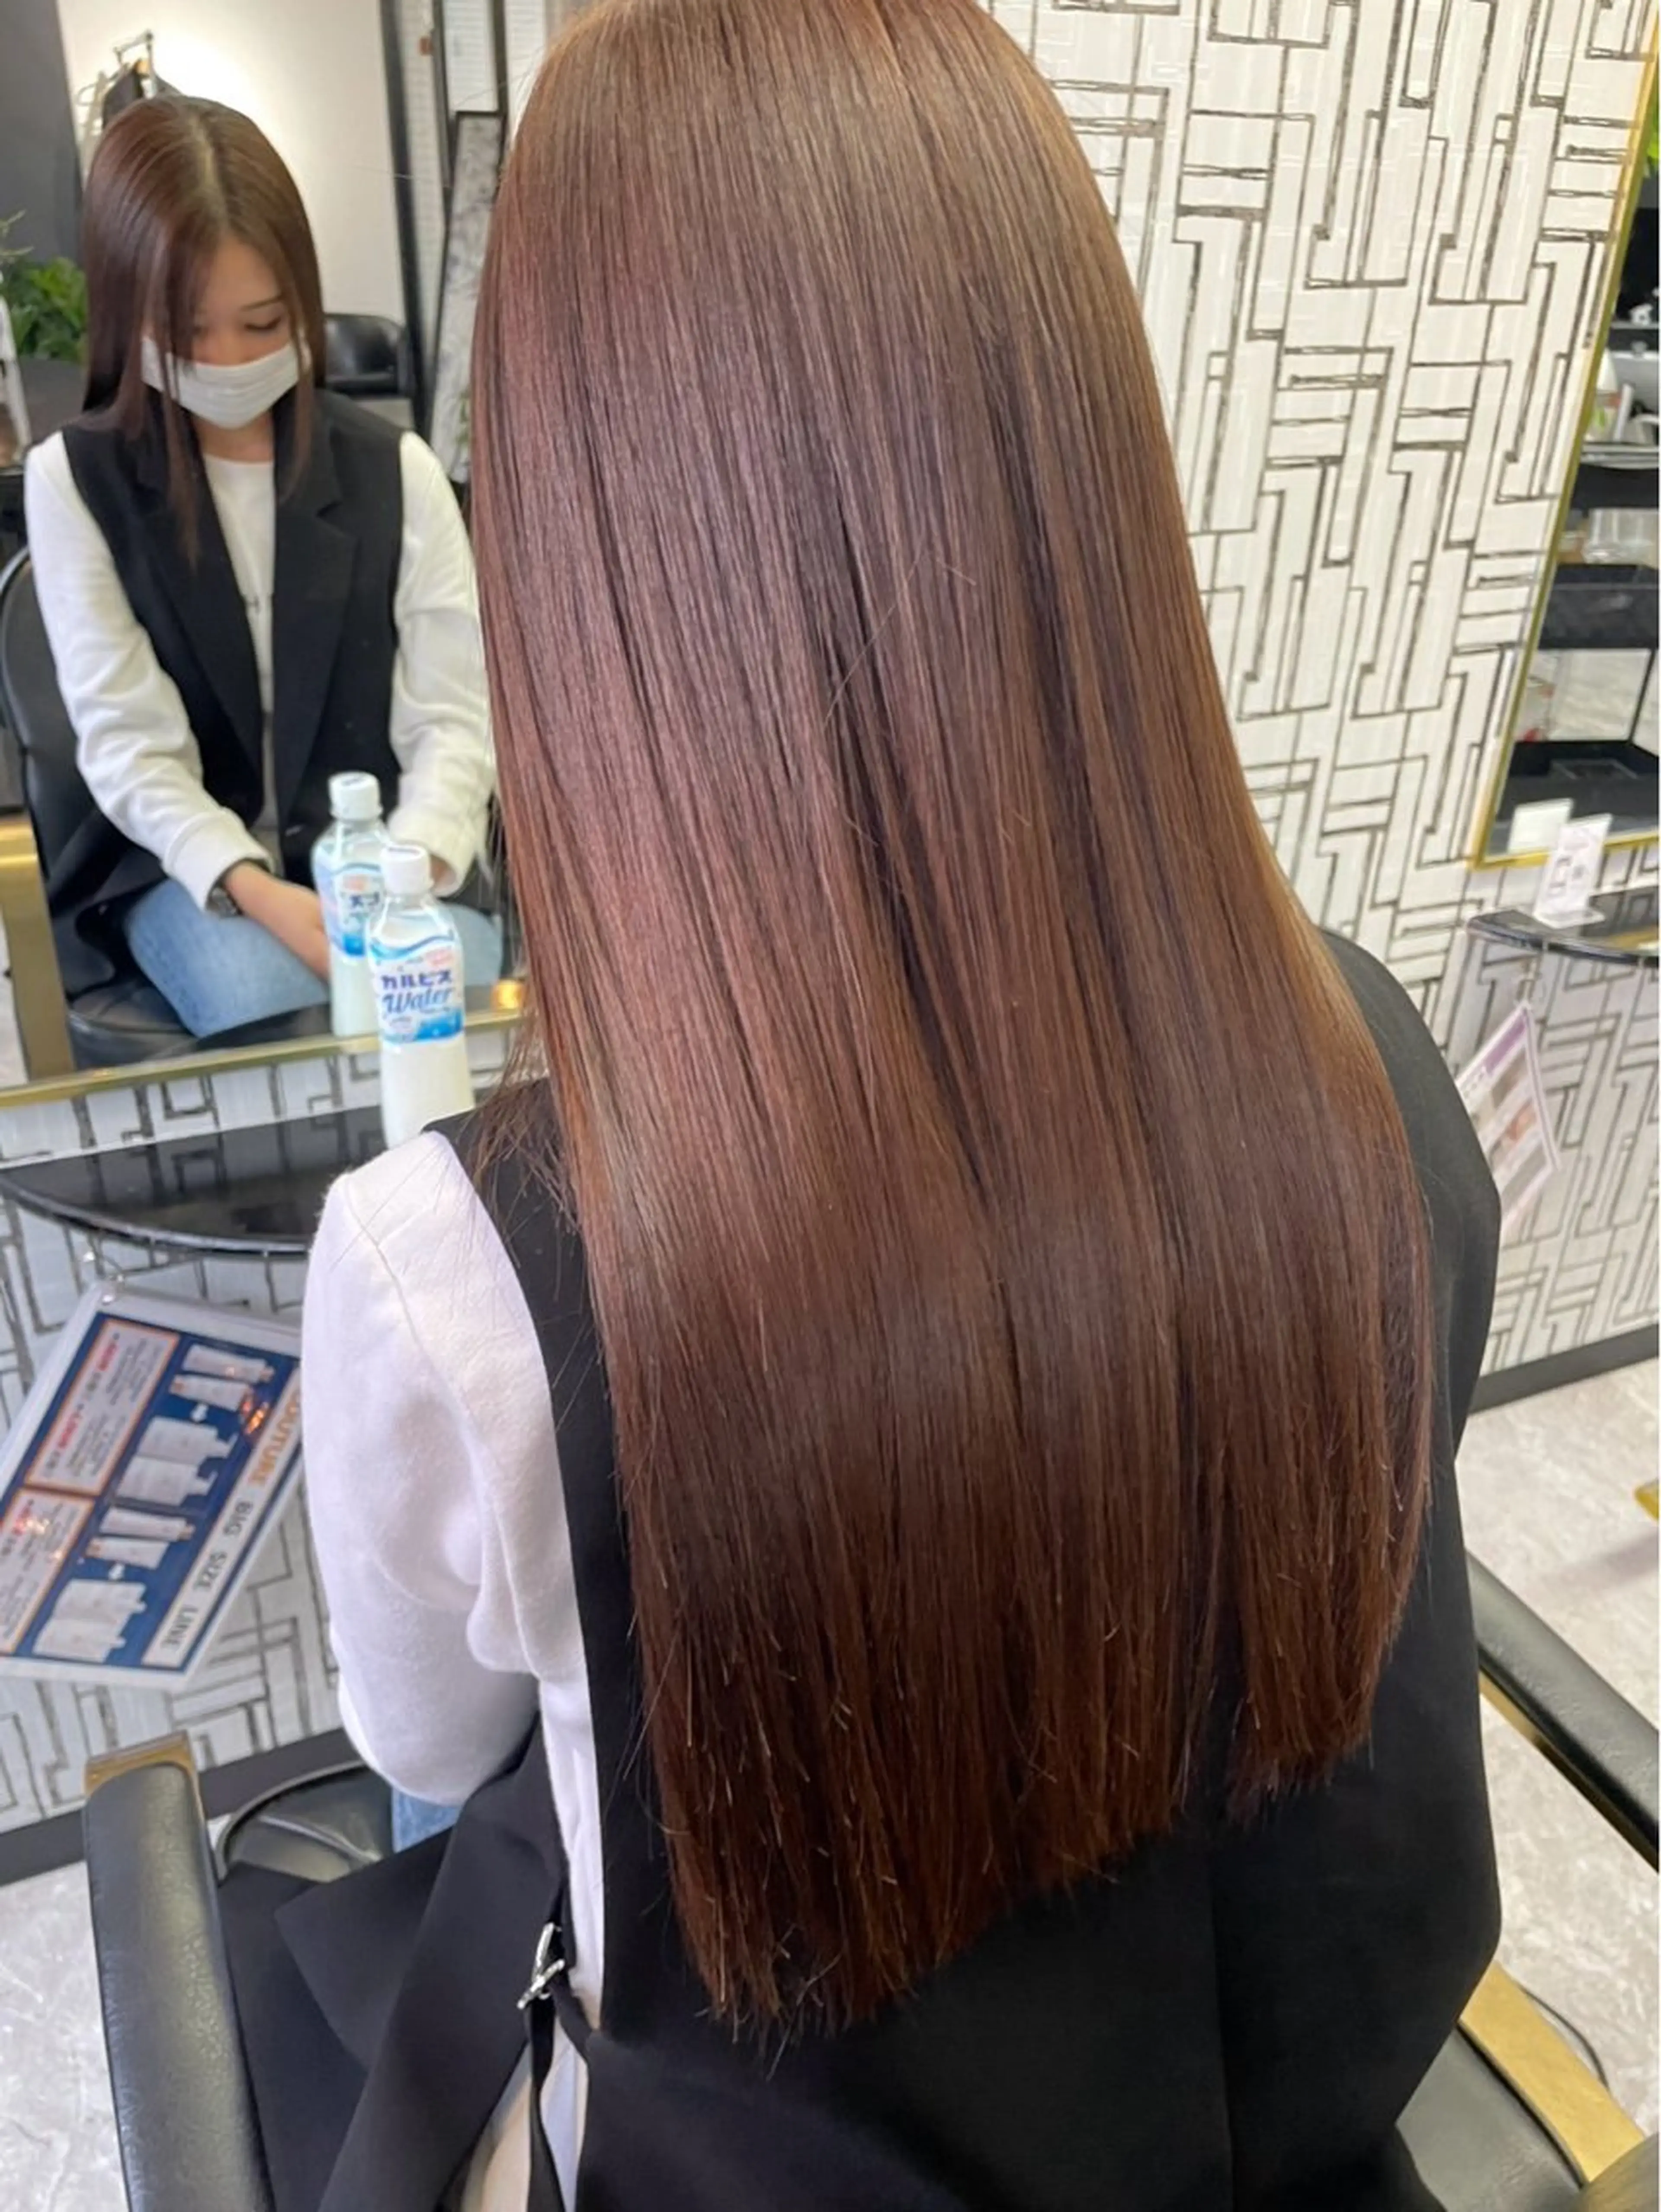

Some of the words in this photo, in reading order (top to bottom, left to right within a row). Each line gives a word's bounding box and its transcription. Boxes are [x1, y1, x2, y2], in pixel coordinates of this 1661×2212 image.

[382, 969, 452, 990] カルピス
[382, 987, 454, 1013] Water
[223, 1500, 254, 1535] BIG
[194, 1551, 228, 1589] SIZE
[160, 1606, 199, 1649] LINE
